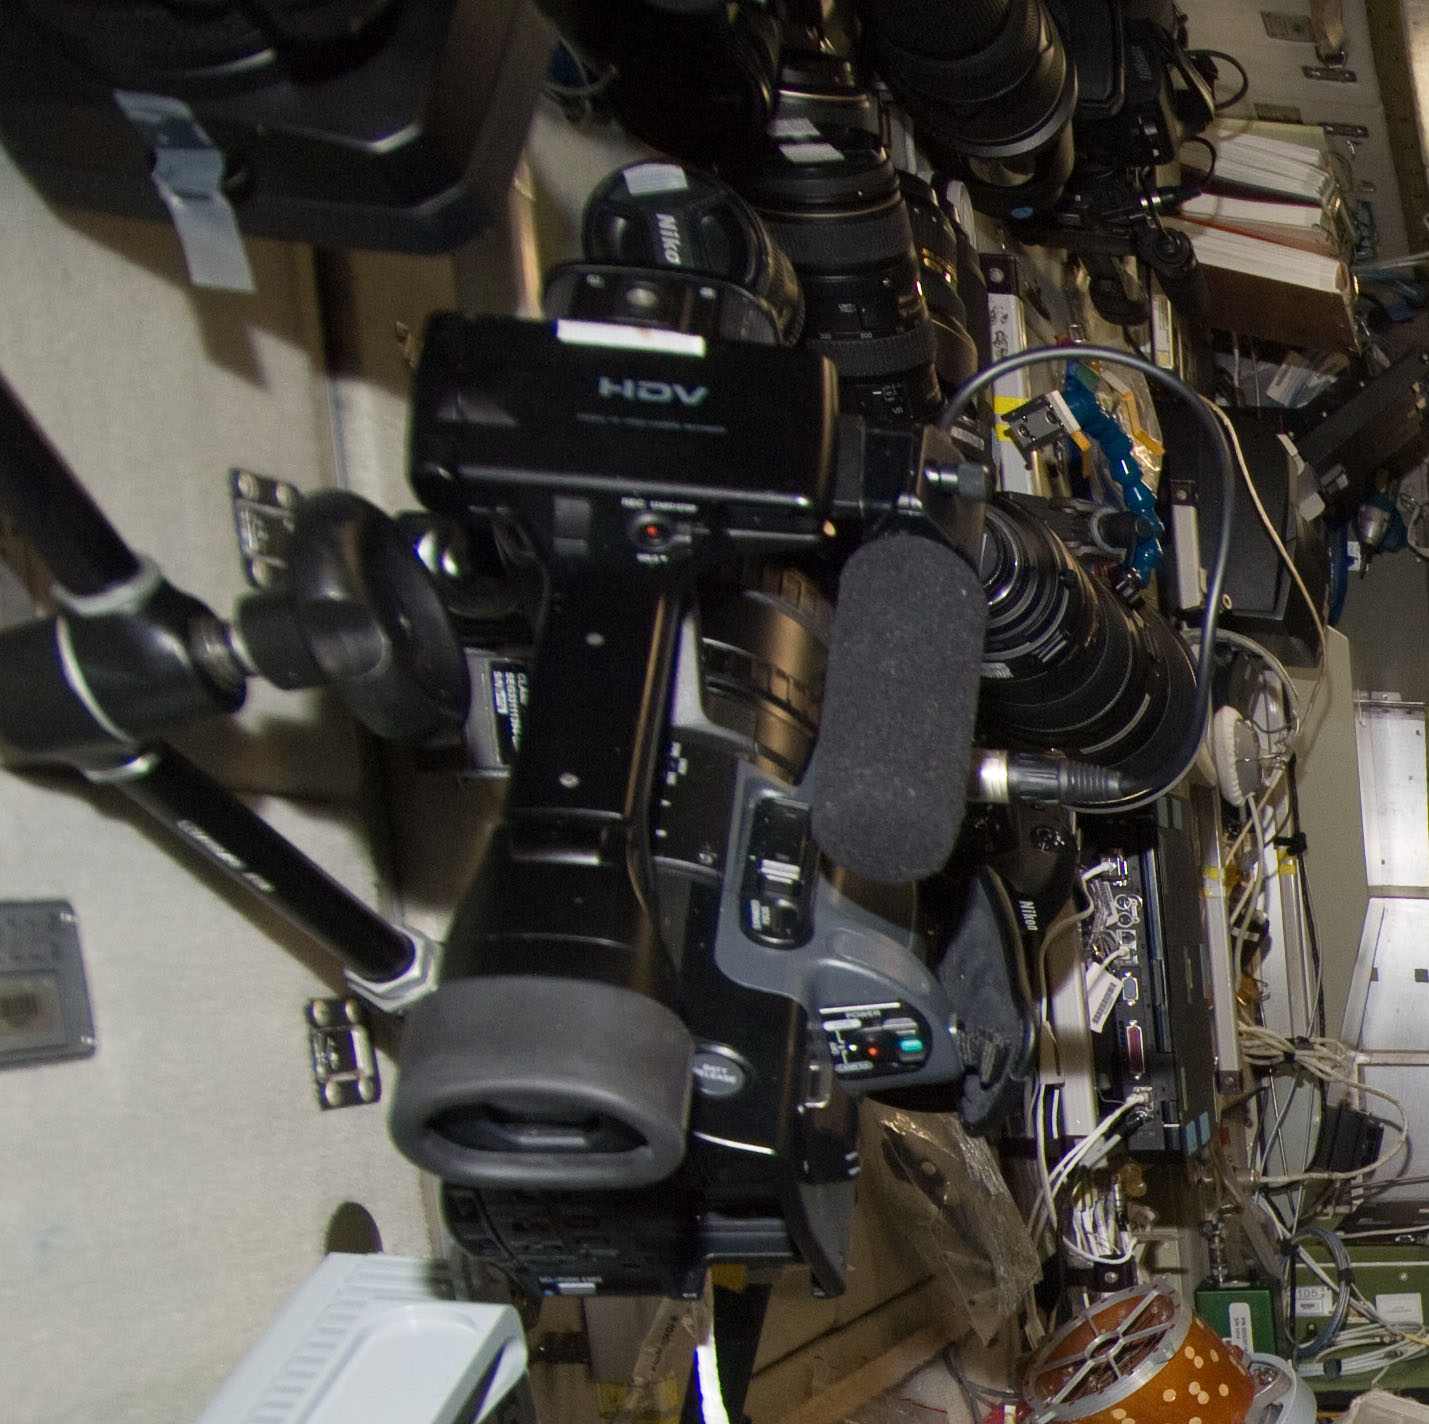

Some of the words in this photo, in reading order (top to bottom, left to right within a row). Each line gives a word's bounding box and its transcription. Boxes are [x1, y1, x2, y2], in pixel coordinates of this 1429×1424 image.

[656, 213, 682, 265] Niko
[598, 376, 708, 406] HDV
[1019, 901, 1039, 931] Nikon
